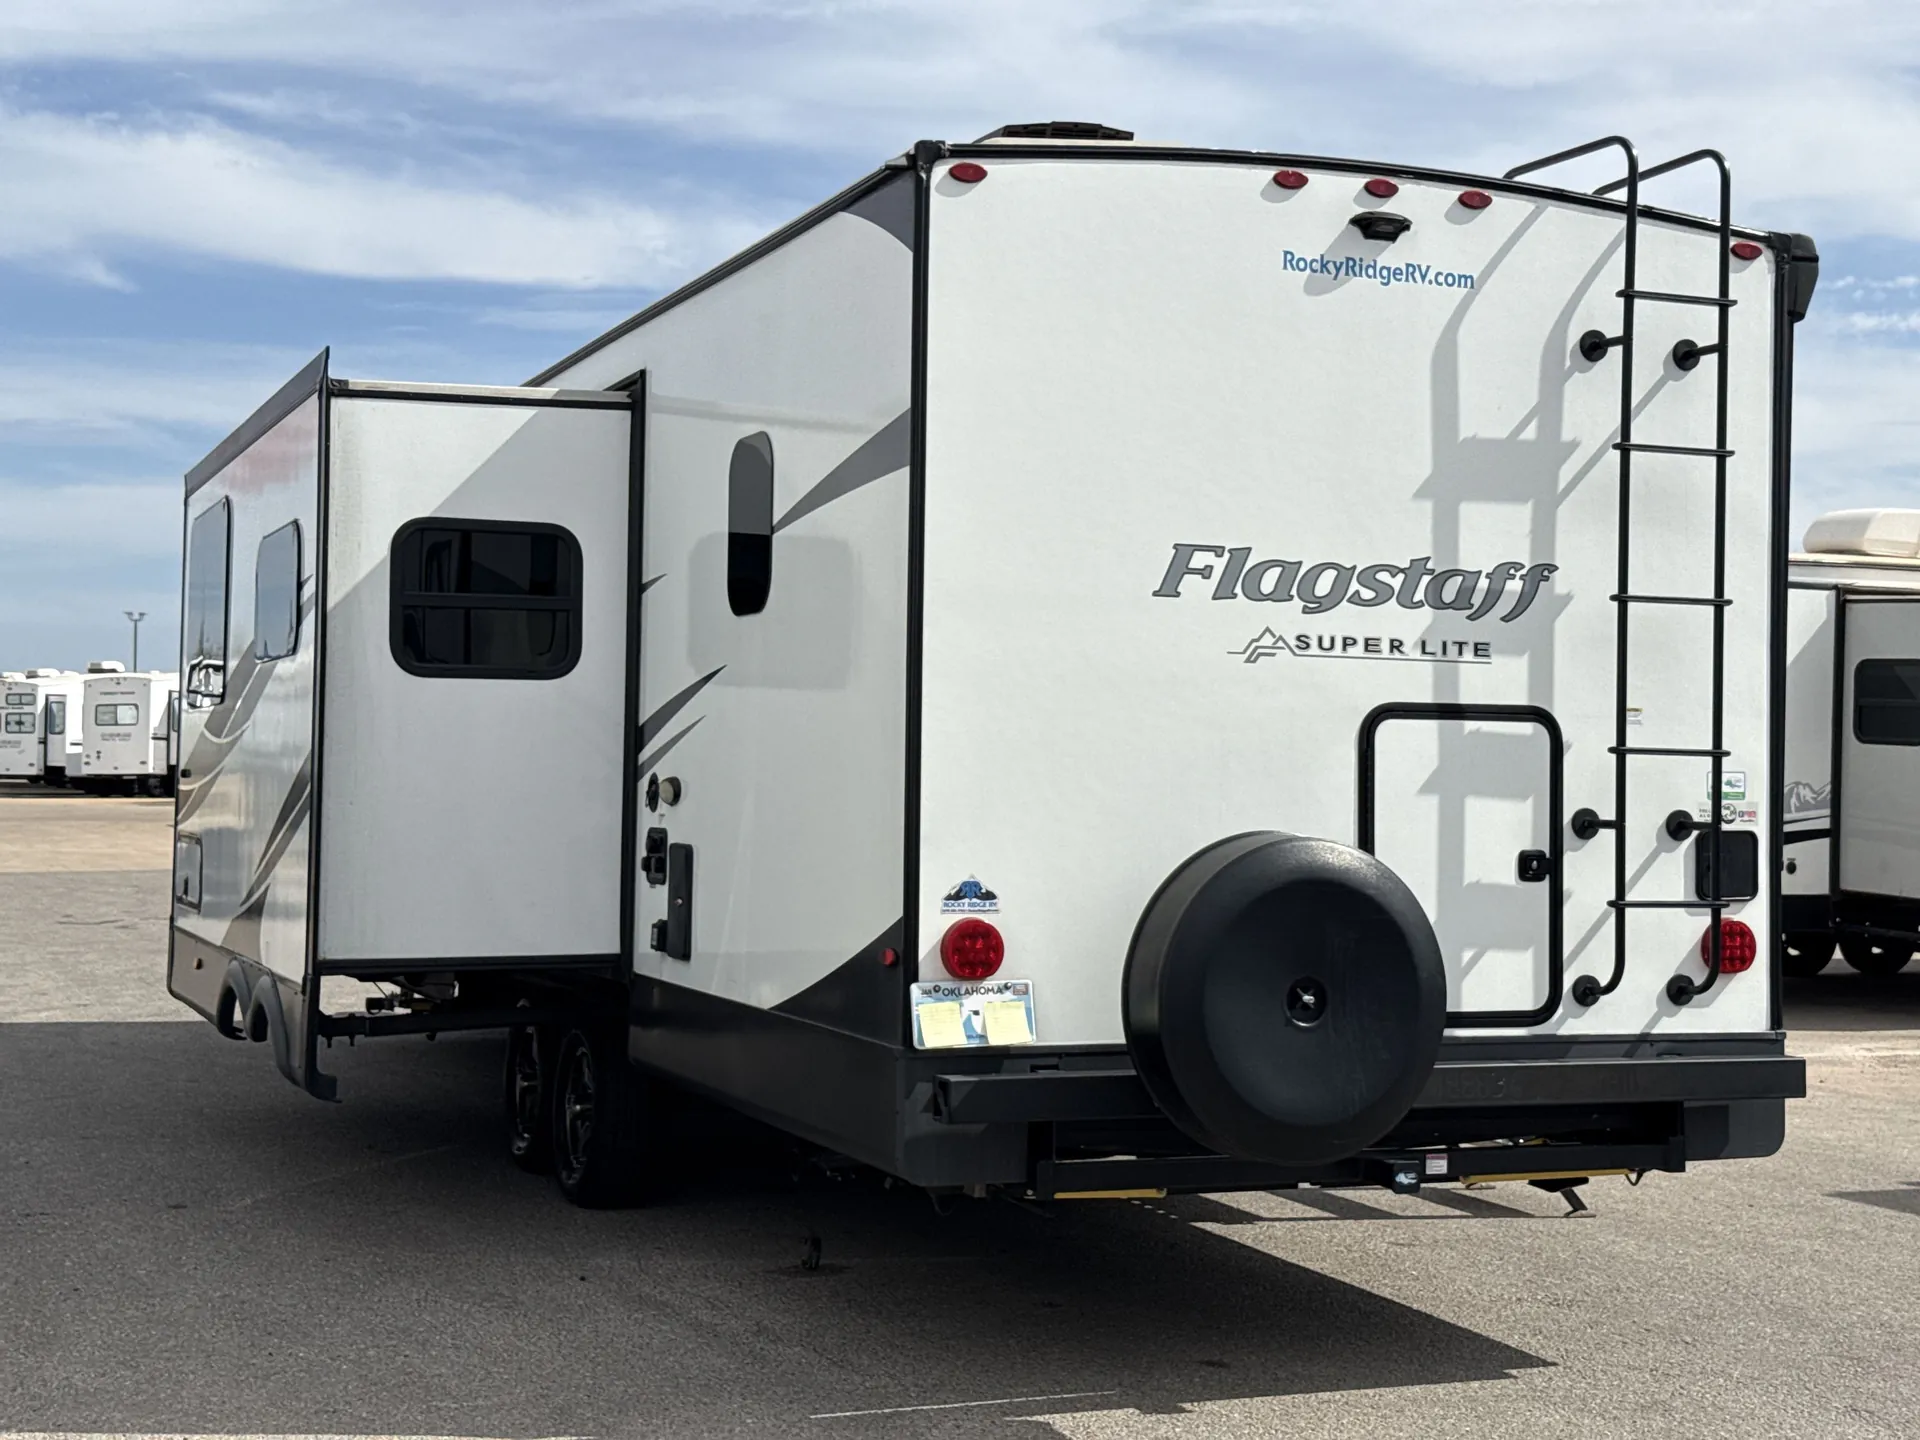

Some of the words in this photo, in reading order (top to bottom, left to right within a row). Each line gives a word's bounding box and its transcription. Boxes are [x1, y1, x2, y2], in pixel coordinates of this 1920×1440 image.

[1281, 249, 1475, 289] RockyRidgeRV.com
[1152, 543, 1560, 623] Flagstaff
[1294, 633, 1406, 656] SUPER
[1420, 639, 1492, 659] LITE
[941, 985, 1004, 998] OKLAHOMA
